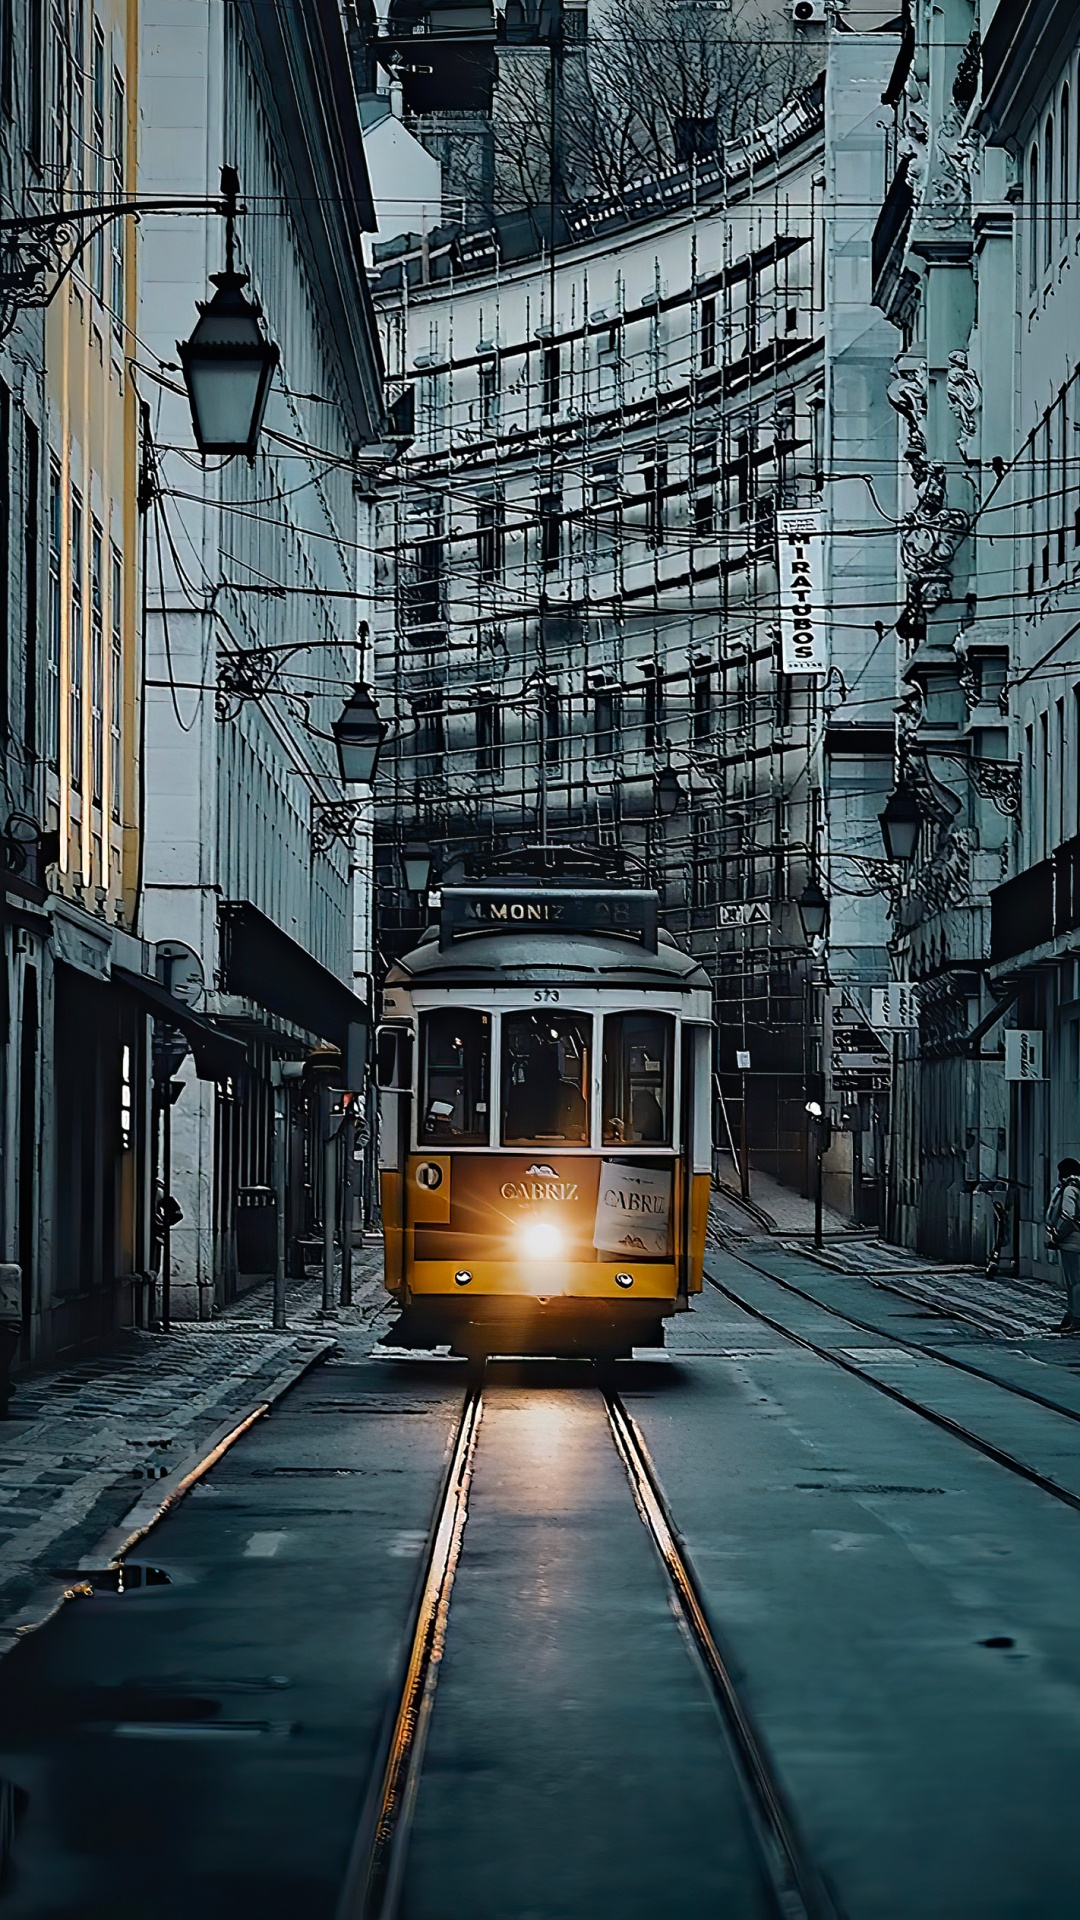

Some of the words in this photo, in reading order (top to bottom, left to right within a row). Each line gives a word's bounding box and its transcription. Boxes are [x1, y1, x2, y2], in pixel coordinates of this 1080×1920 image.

[788, 532, 814, 659] MIRATUBOS
[534, 989, 560, 1002] 573
[500, 1182, 579, 1200] CABRIZ
[604, 1189, 665, 1214] CABRIZ
